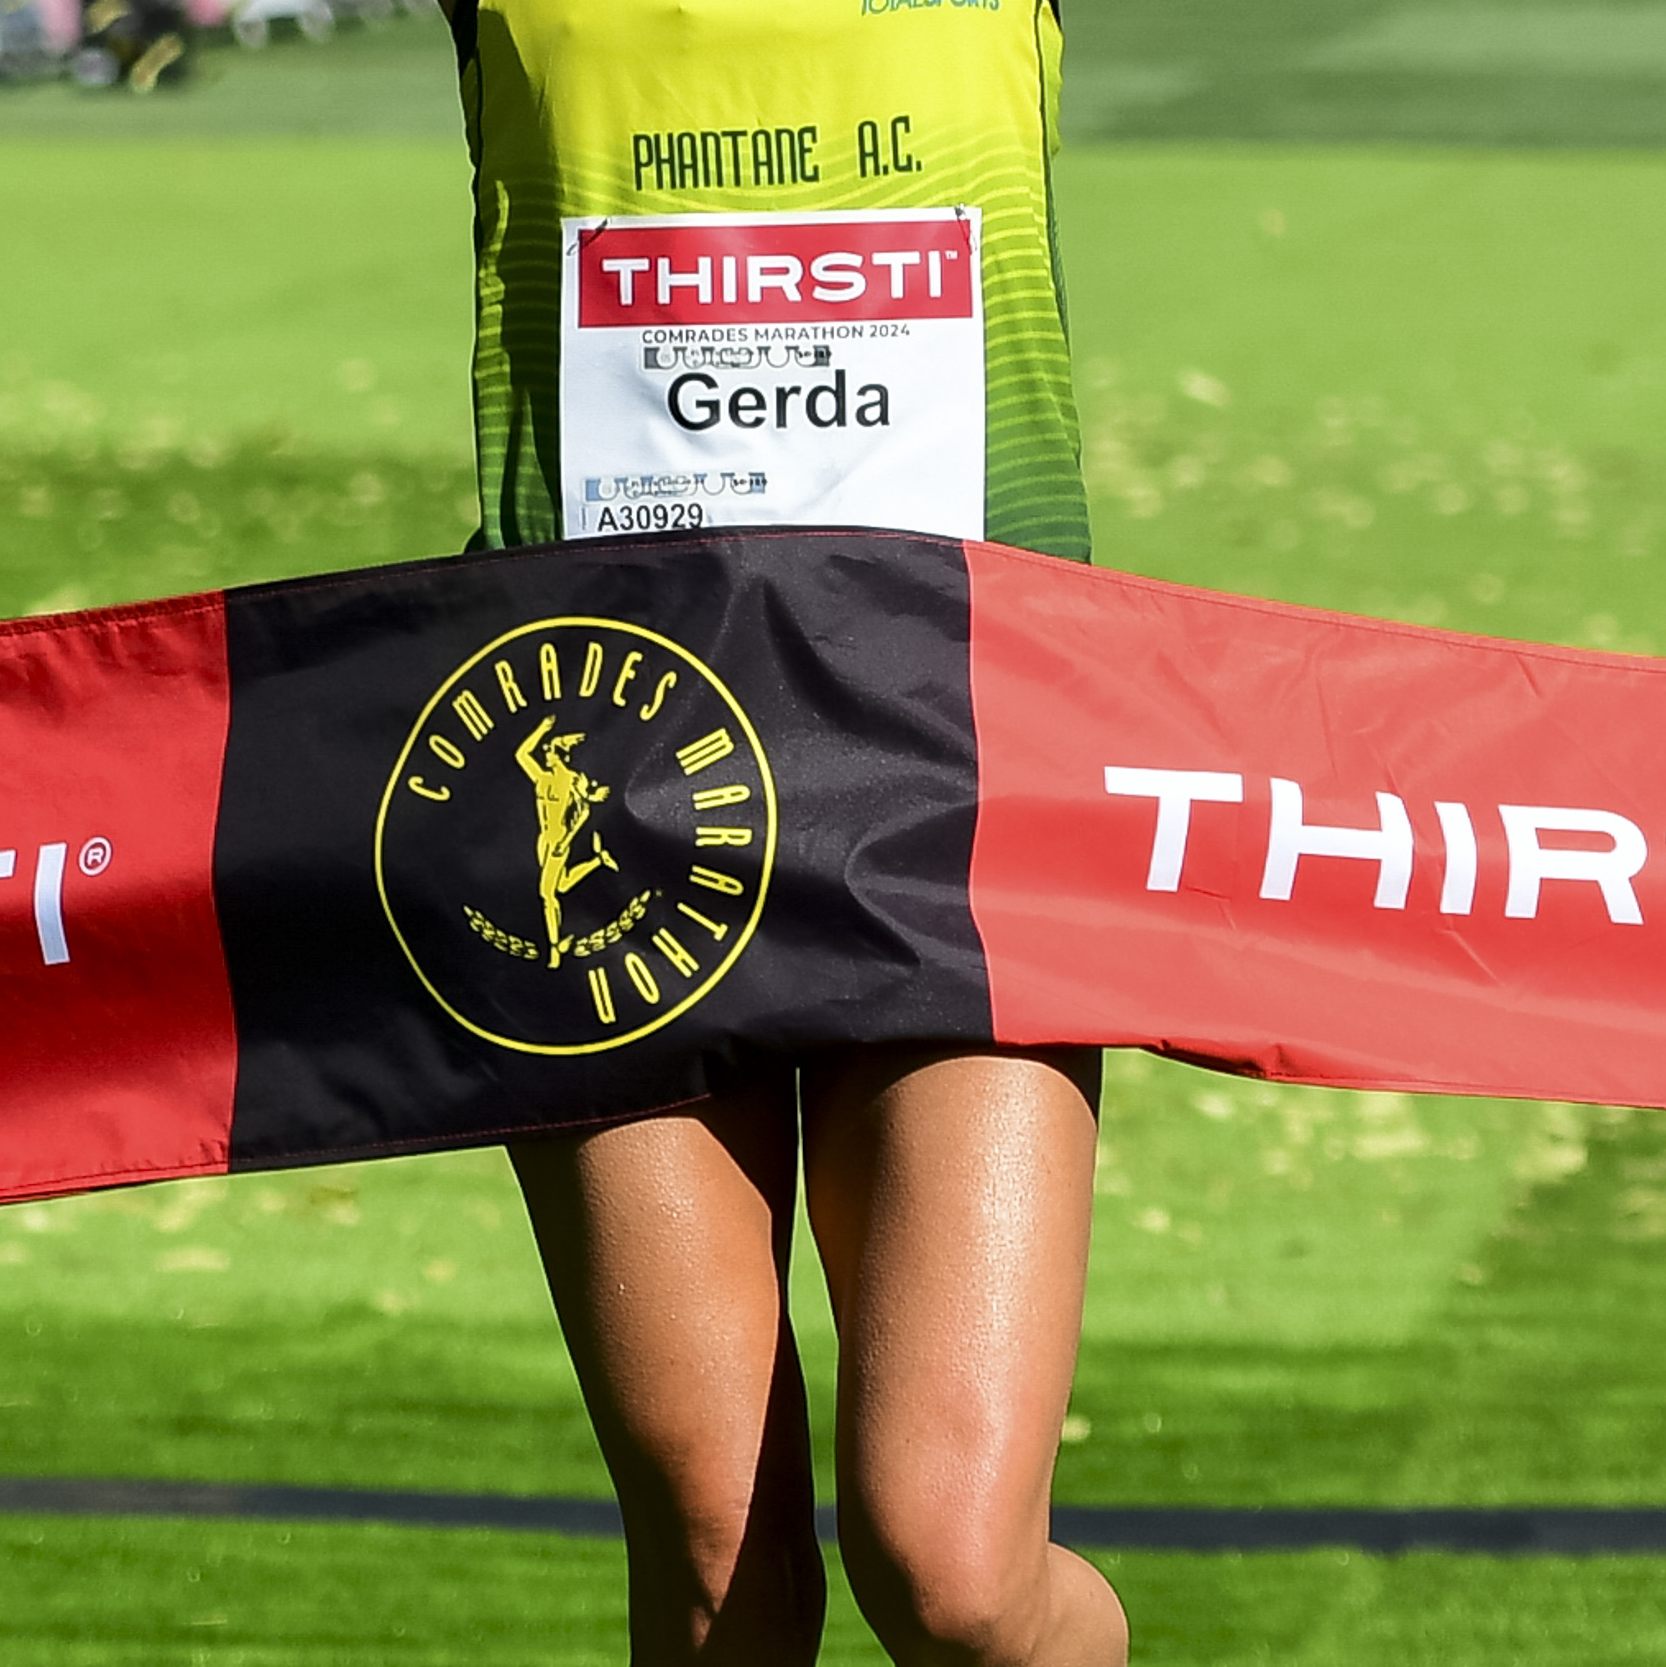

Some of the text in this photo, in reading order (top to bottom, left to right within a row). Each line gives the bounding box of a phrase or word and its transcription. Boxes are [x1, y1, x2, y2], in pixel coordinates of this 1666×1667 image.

[633, 115, 923, 191] PHANTANE A.C.
[641, 323, 911, 344] COMRADES MARATHON 2024
[666, 368, 890, 431] Gerda
[597, 502, 704, 532] A30929
[407, 641, 678, 803] COMRADES
[588, 726, 754, 1024] MARATHON
